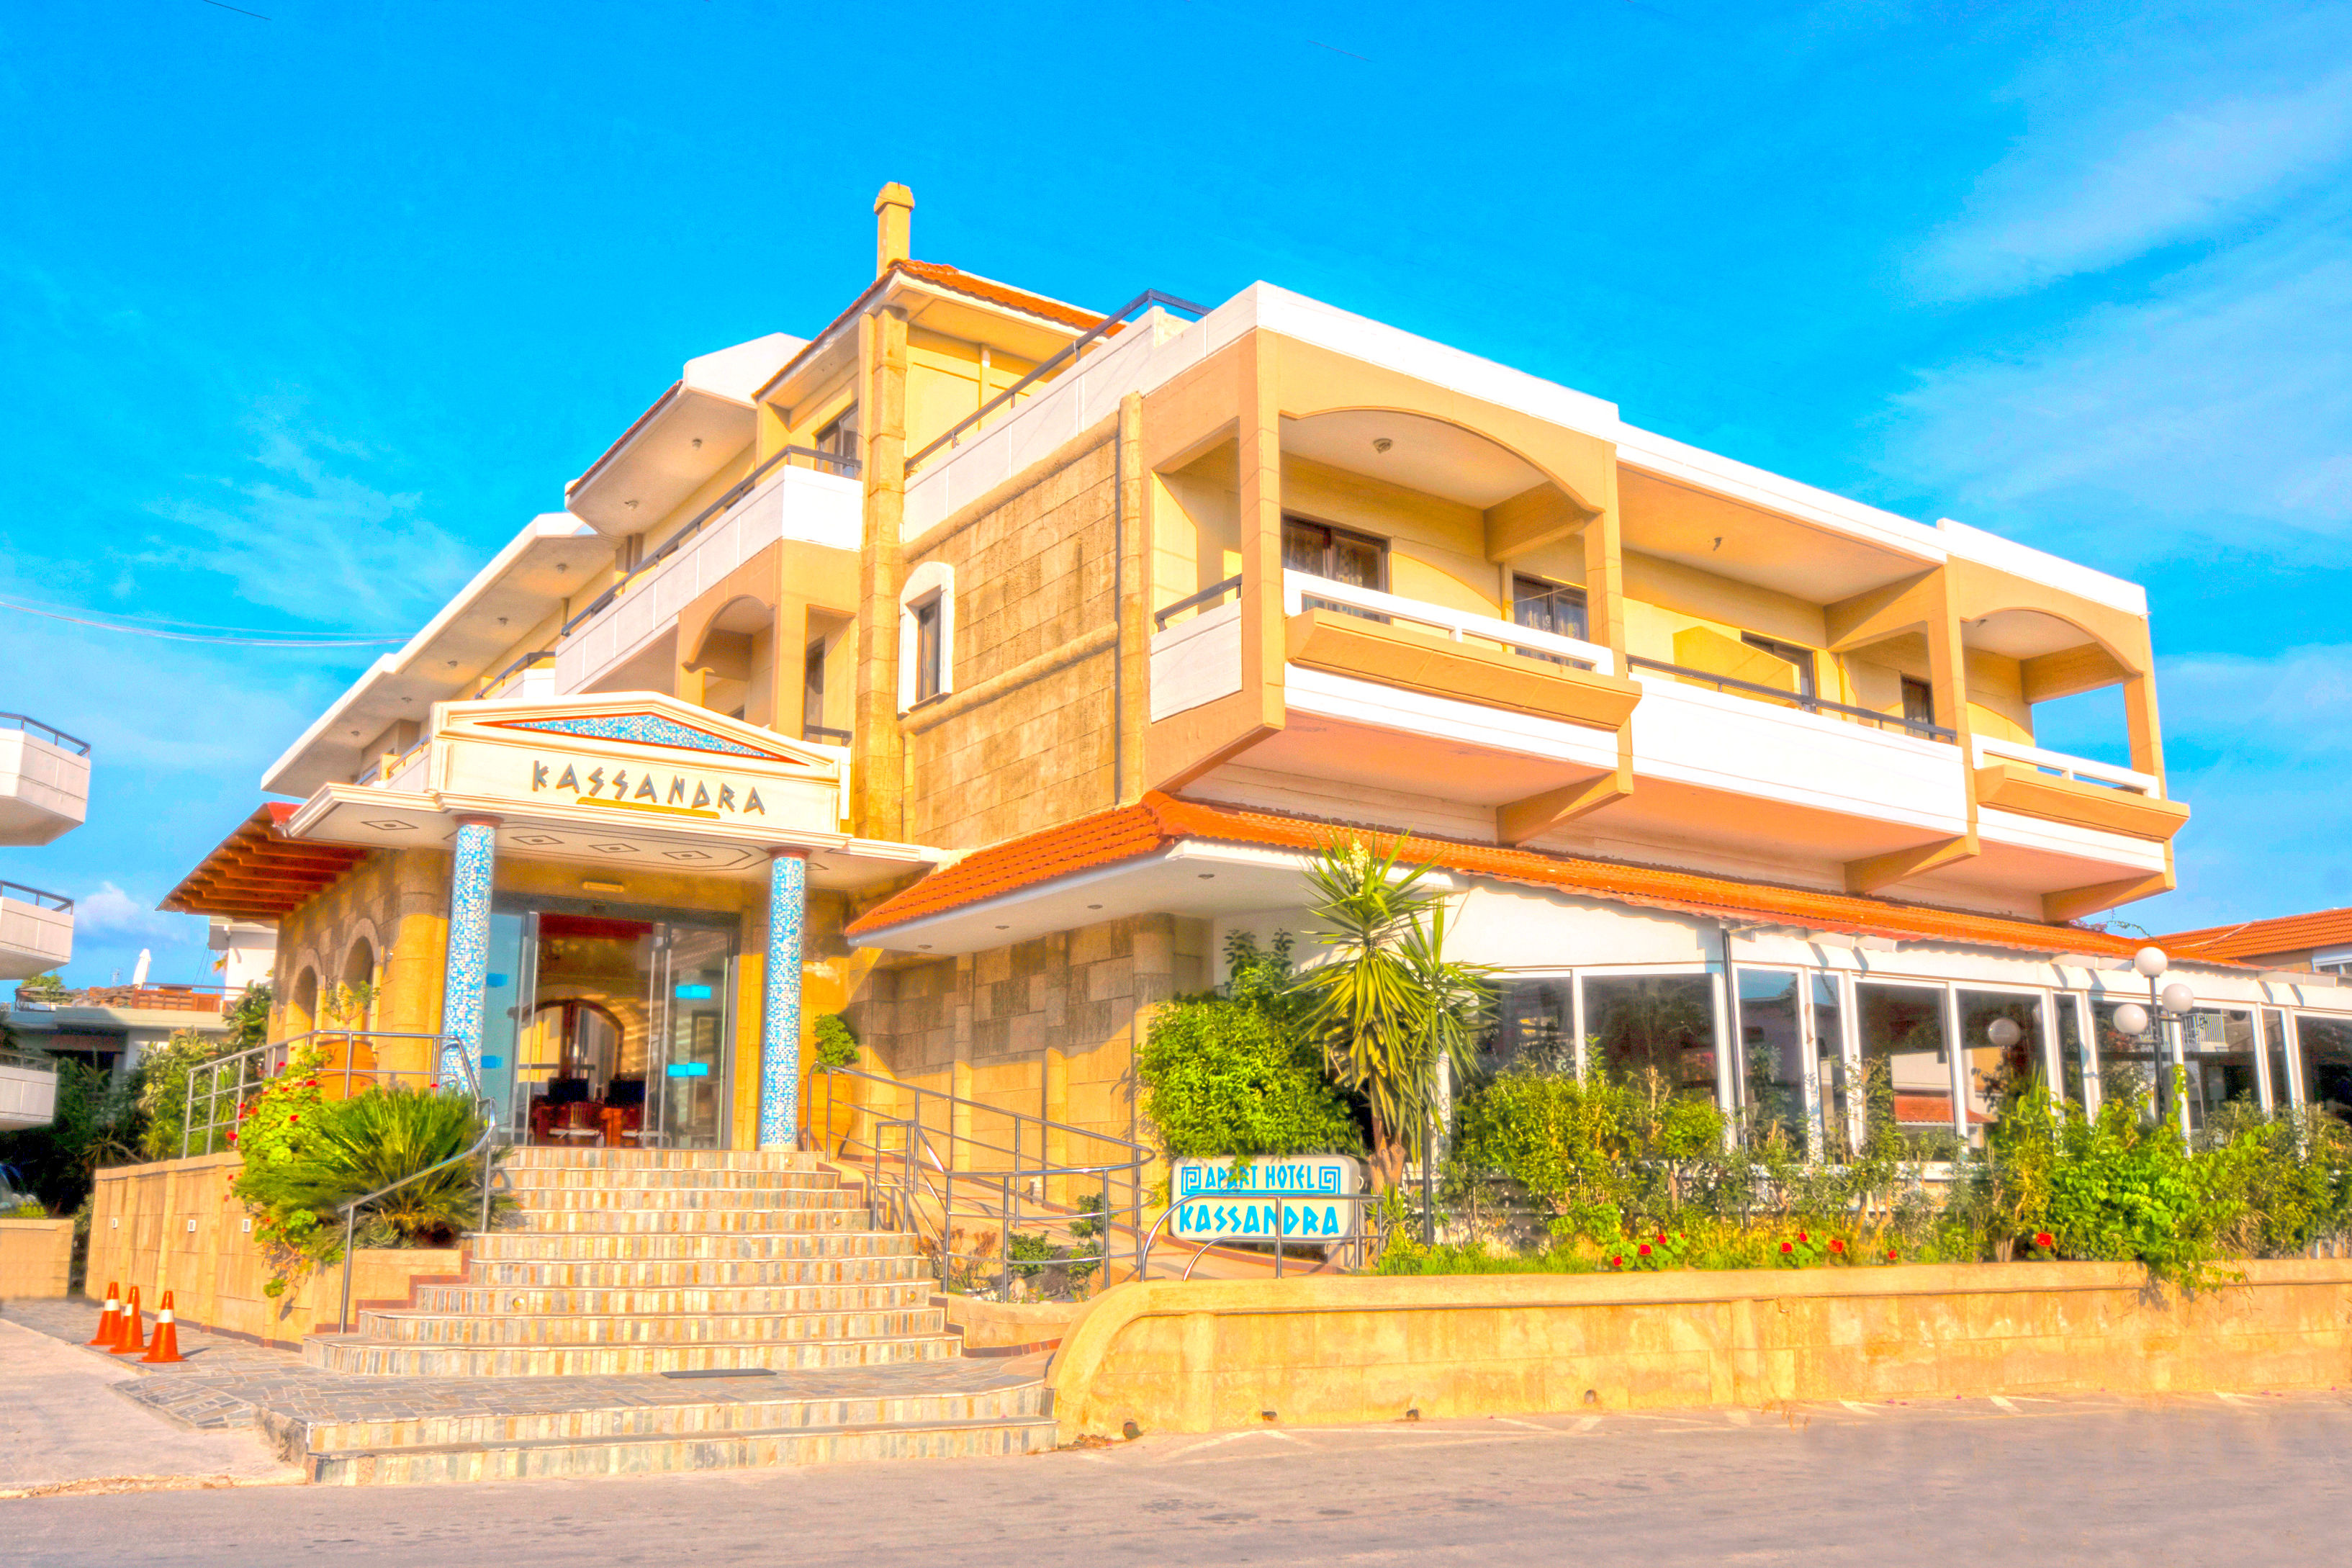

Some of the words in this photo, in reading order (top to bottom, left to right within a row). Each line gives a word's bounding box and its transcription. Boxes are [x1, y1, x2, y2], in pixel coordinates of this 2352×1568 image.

[533, 760, 765, 815] KASSANDRA
[1266, 1164, 1315, 1189] HOTEL
[1179, 1204, 1339, 1235] KASSANDRA
